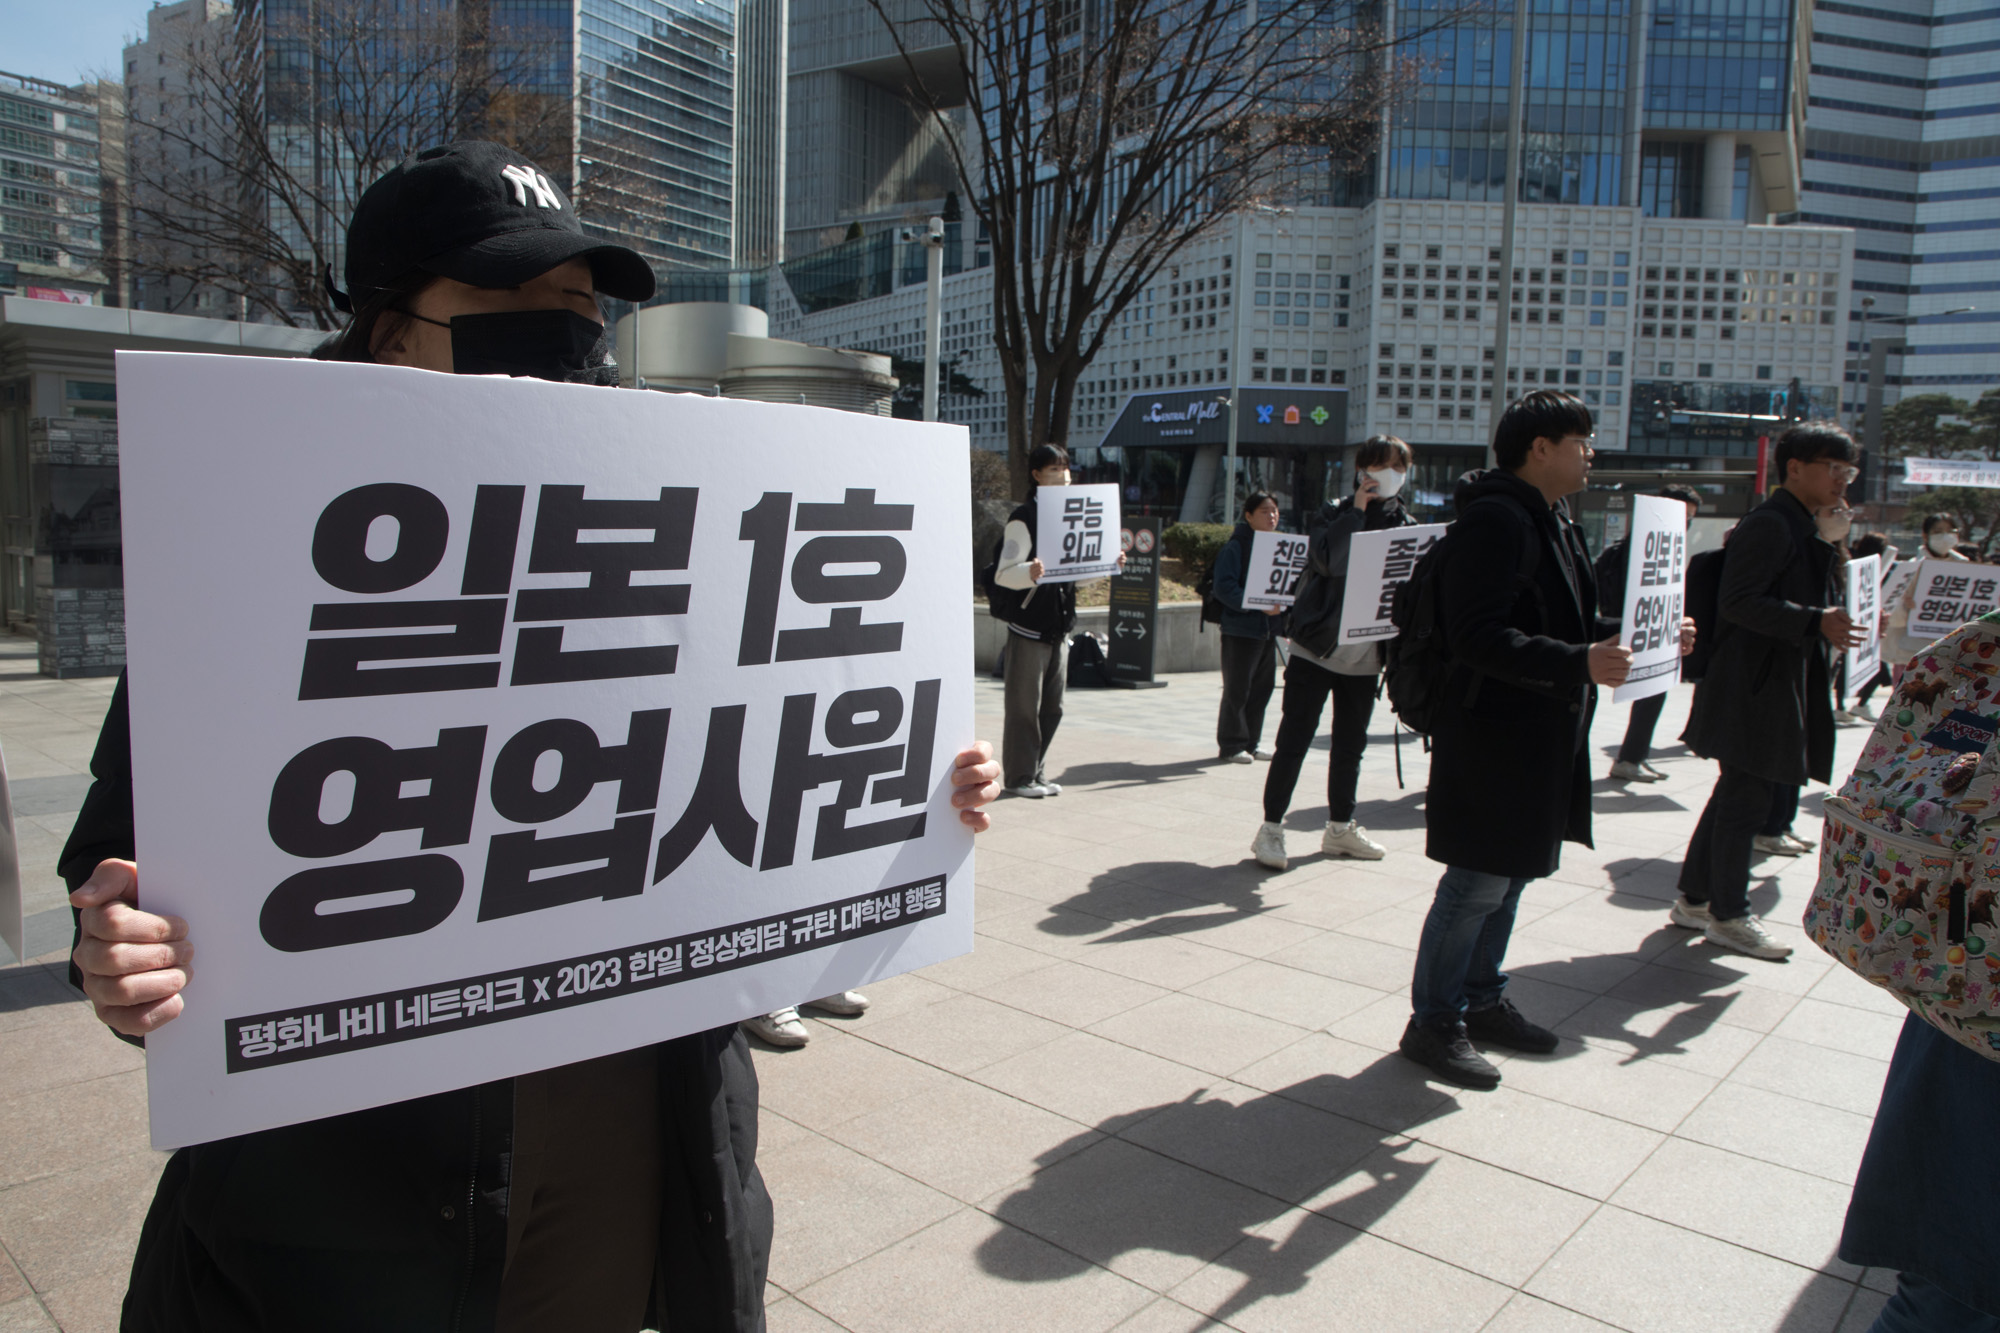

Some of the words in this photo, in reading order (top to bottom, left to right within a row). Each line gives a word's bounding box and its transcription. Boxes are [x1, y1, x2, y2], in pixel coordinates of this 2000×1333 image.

[1186, 400, 1220, 425] Mall
[1062, 496, 1104, 530] 무능
[1059, 531, 1104, 565] 외교
[1640, 530, 1672, 587] 일본
[298, 482, 700, 702] 일본
[736, 487, 915, 668] 1호
[1928, 574, 1970, 598] 일본
[1969, 578, 1998, 600] 1호
[1630, 593, 1683, 654] 영업사원
[1934, 718, 1995, 744] JANSPORT
[258, 678, 942, 954] 영업사원
[238, 1001, 386, 1059] 평화나비
[395, 976, 526, 1030] 네트워크
[556, 957, 622, 998] 2023
[628, 943, 683, 983] 한일
[688, 920, 788, 969] 정상회담
[791, 910, 837, 944] 규탄
[840, 896, 901, 931] 대학생
[905, 881, 942, 916] 행동
